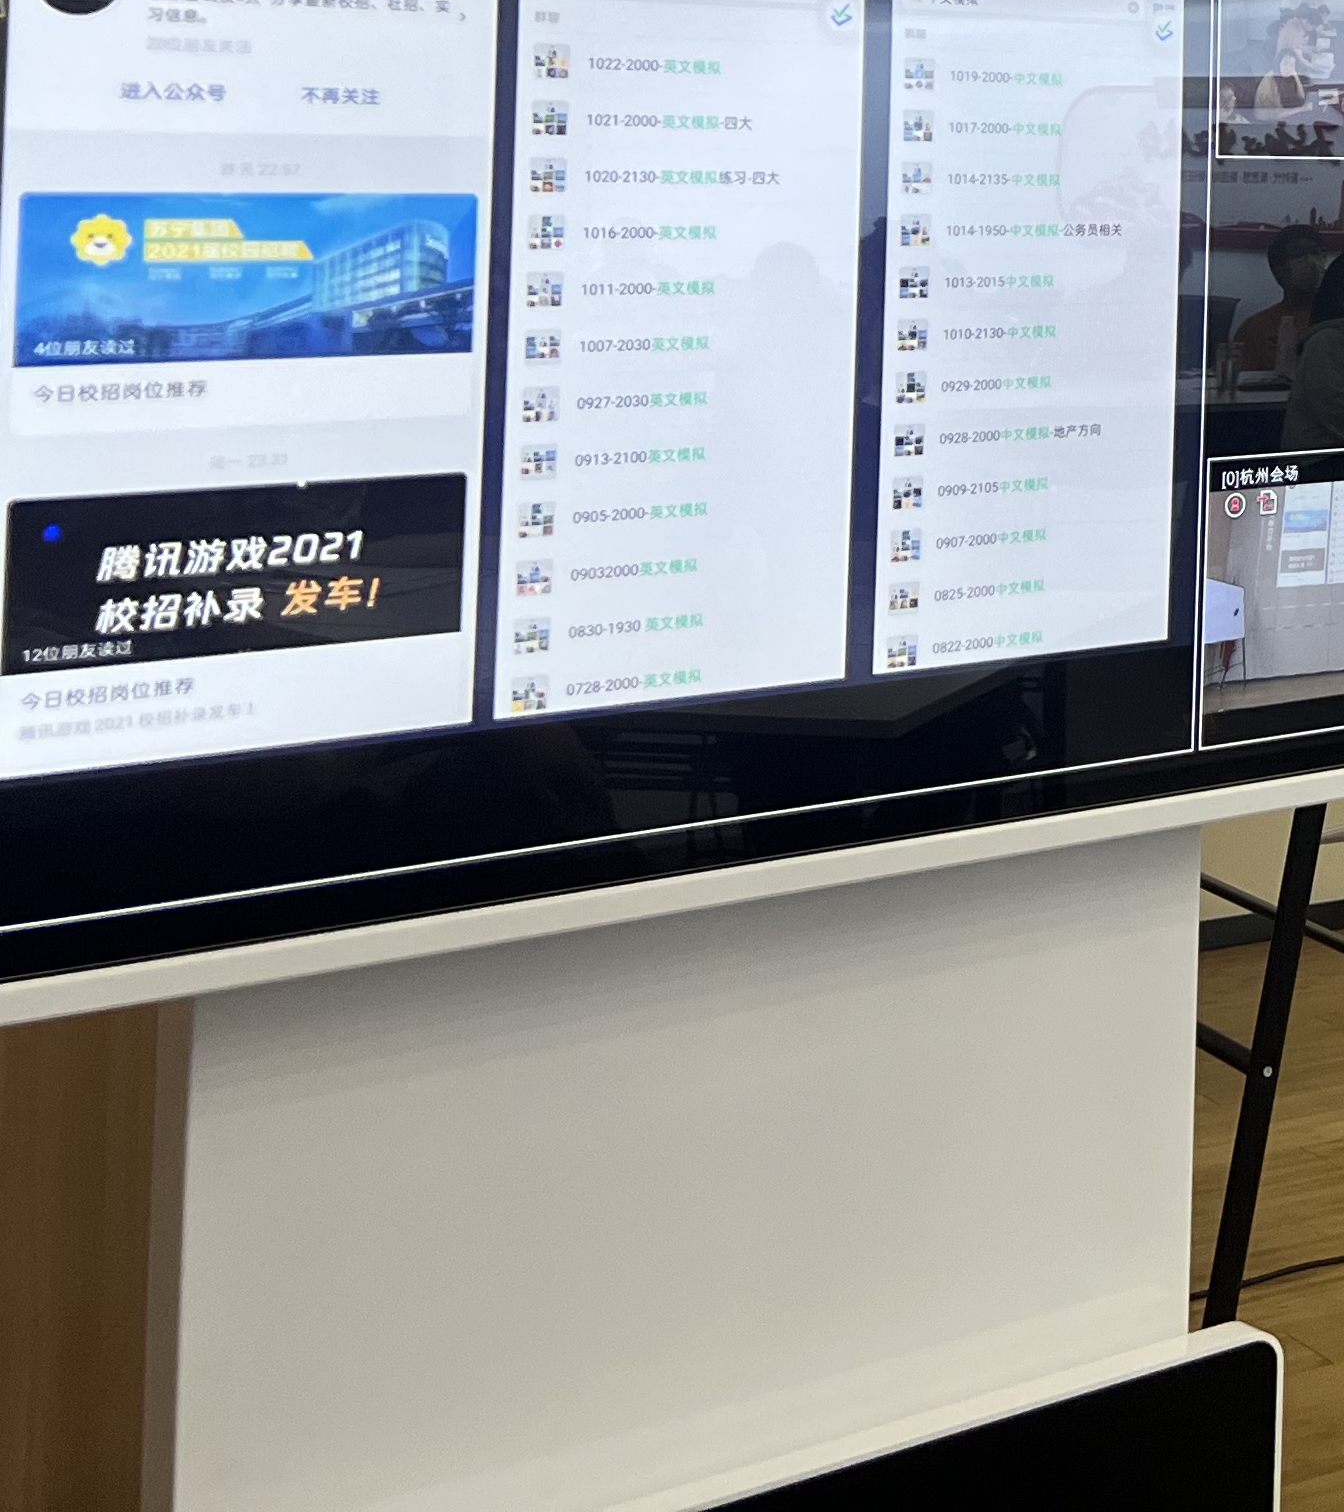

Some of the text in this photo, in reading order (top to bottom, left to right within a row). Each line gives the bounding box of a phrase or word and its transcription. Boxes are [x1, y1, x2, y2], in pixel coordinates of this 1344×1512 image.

[120, 81, 227, 102] 进入公众号
[301, 87, 380, 105] 不再关注
[33, 379, 208, 404] 今日校招岗位推荐
[1222, 465, 1298, 490] [0]杭州会场
[96, 529, 365, 584] 腾讯游戏2021
[94, 587, 266, 635] 校招补录
[21, 677, 195, 710] 今日校招岗位推荐
